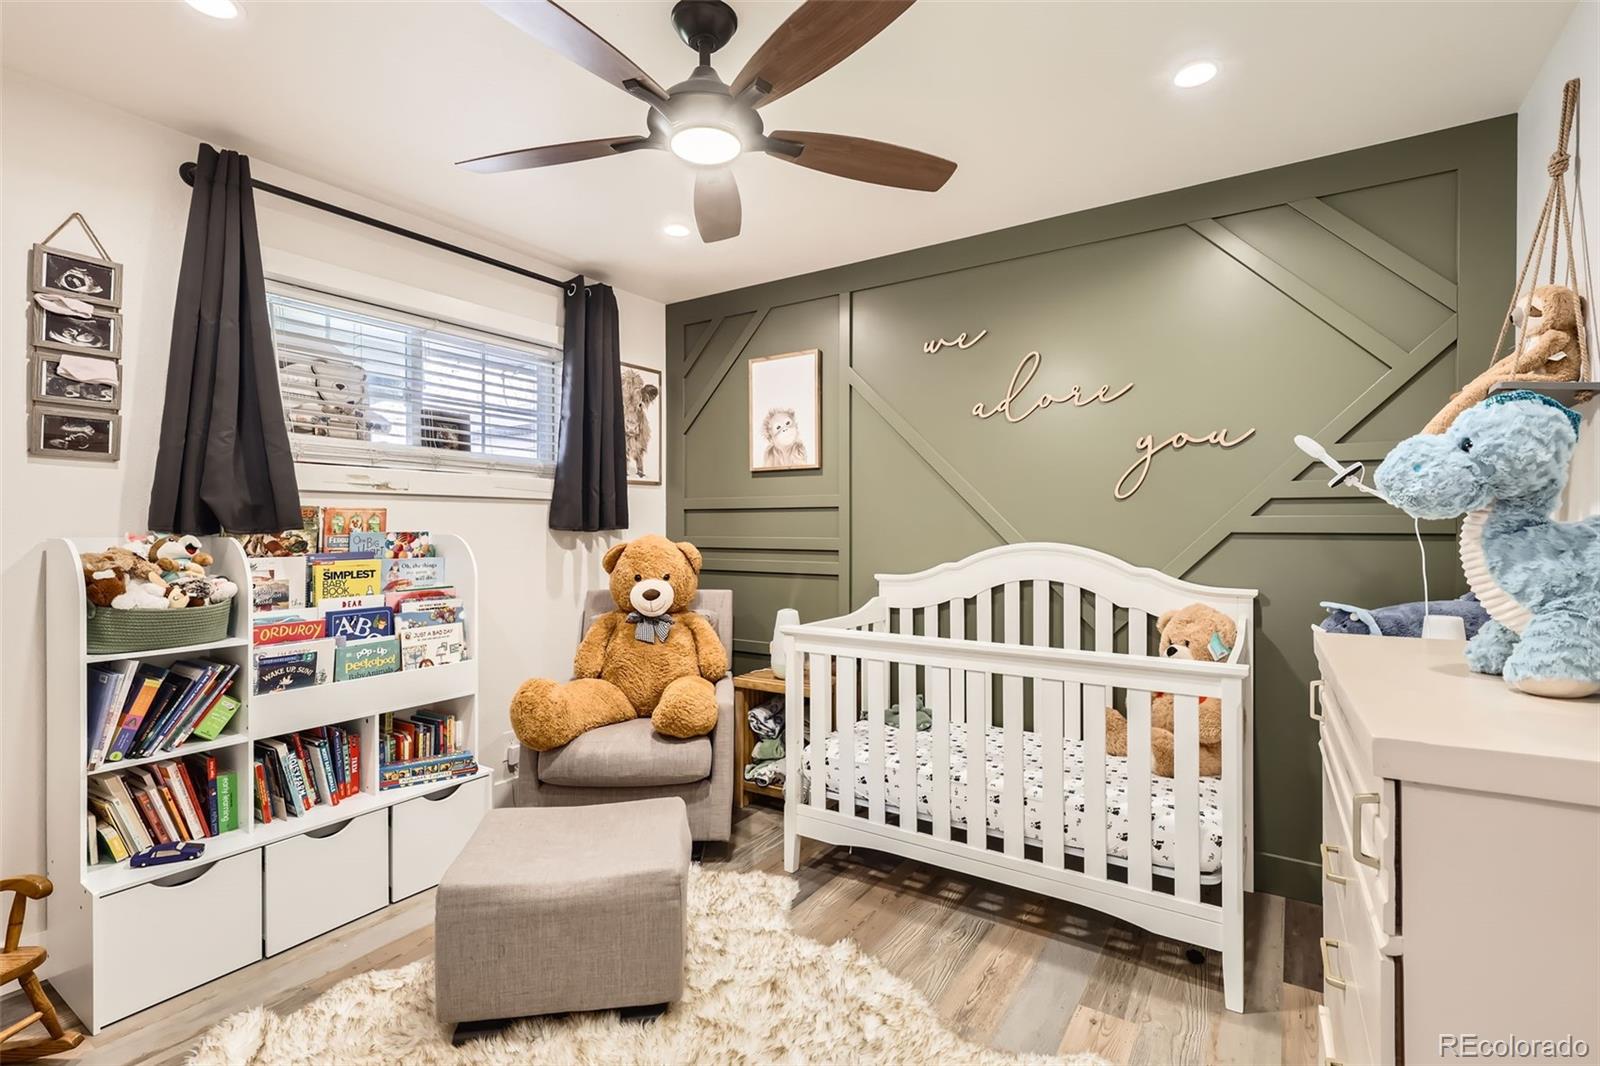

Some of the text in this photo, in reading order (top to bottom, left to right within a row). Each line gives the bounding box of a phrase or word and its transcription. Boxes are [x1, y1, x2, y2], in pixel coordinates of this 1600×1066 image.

[923, 329, 988, 354] we
[971, 351, 1135, 423] adore
[1114, 427, 1256, 500] you
[323, 569, 377, 580] SIMPLEST
[323, 580, 347, 588] BABY
[322, 587, 350, 596] BOOK
[342, 600, 362, 608] DEAR
[261, 667, 285, 682] WAKE
[287, 753, 301, 777] NOISY
[219, 777, 232, 822] early learning
